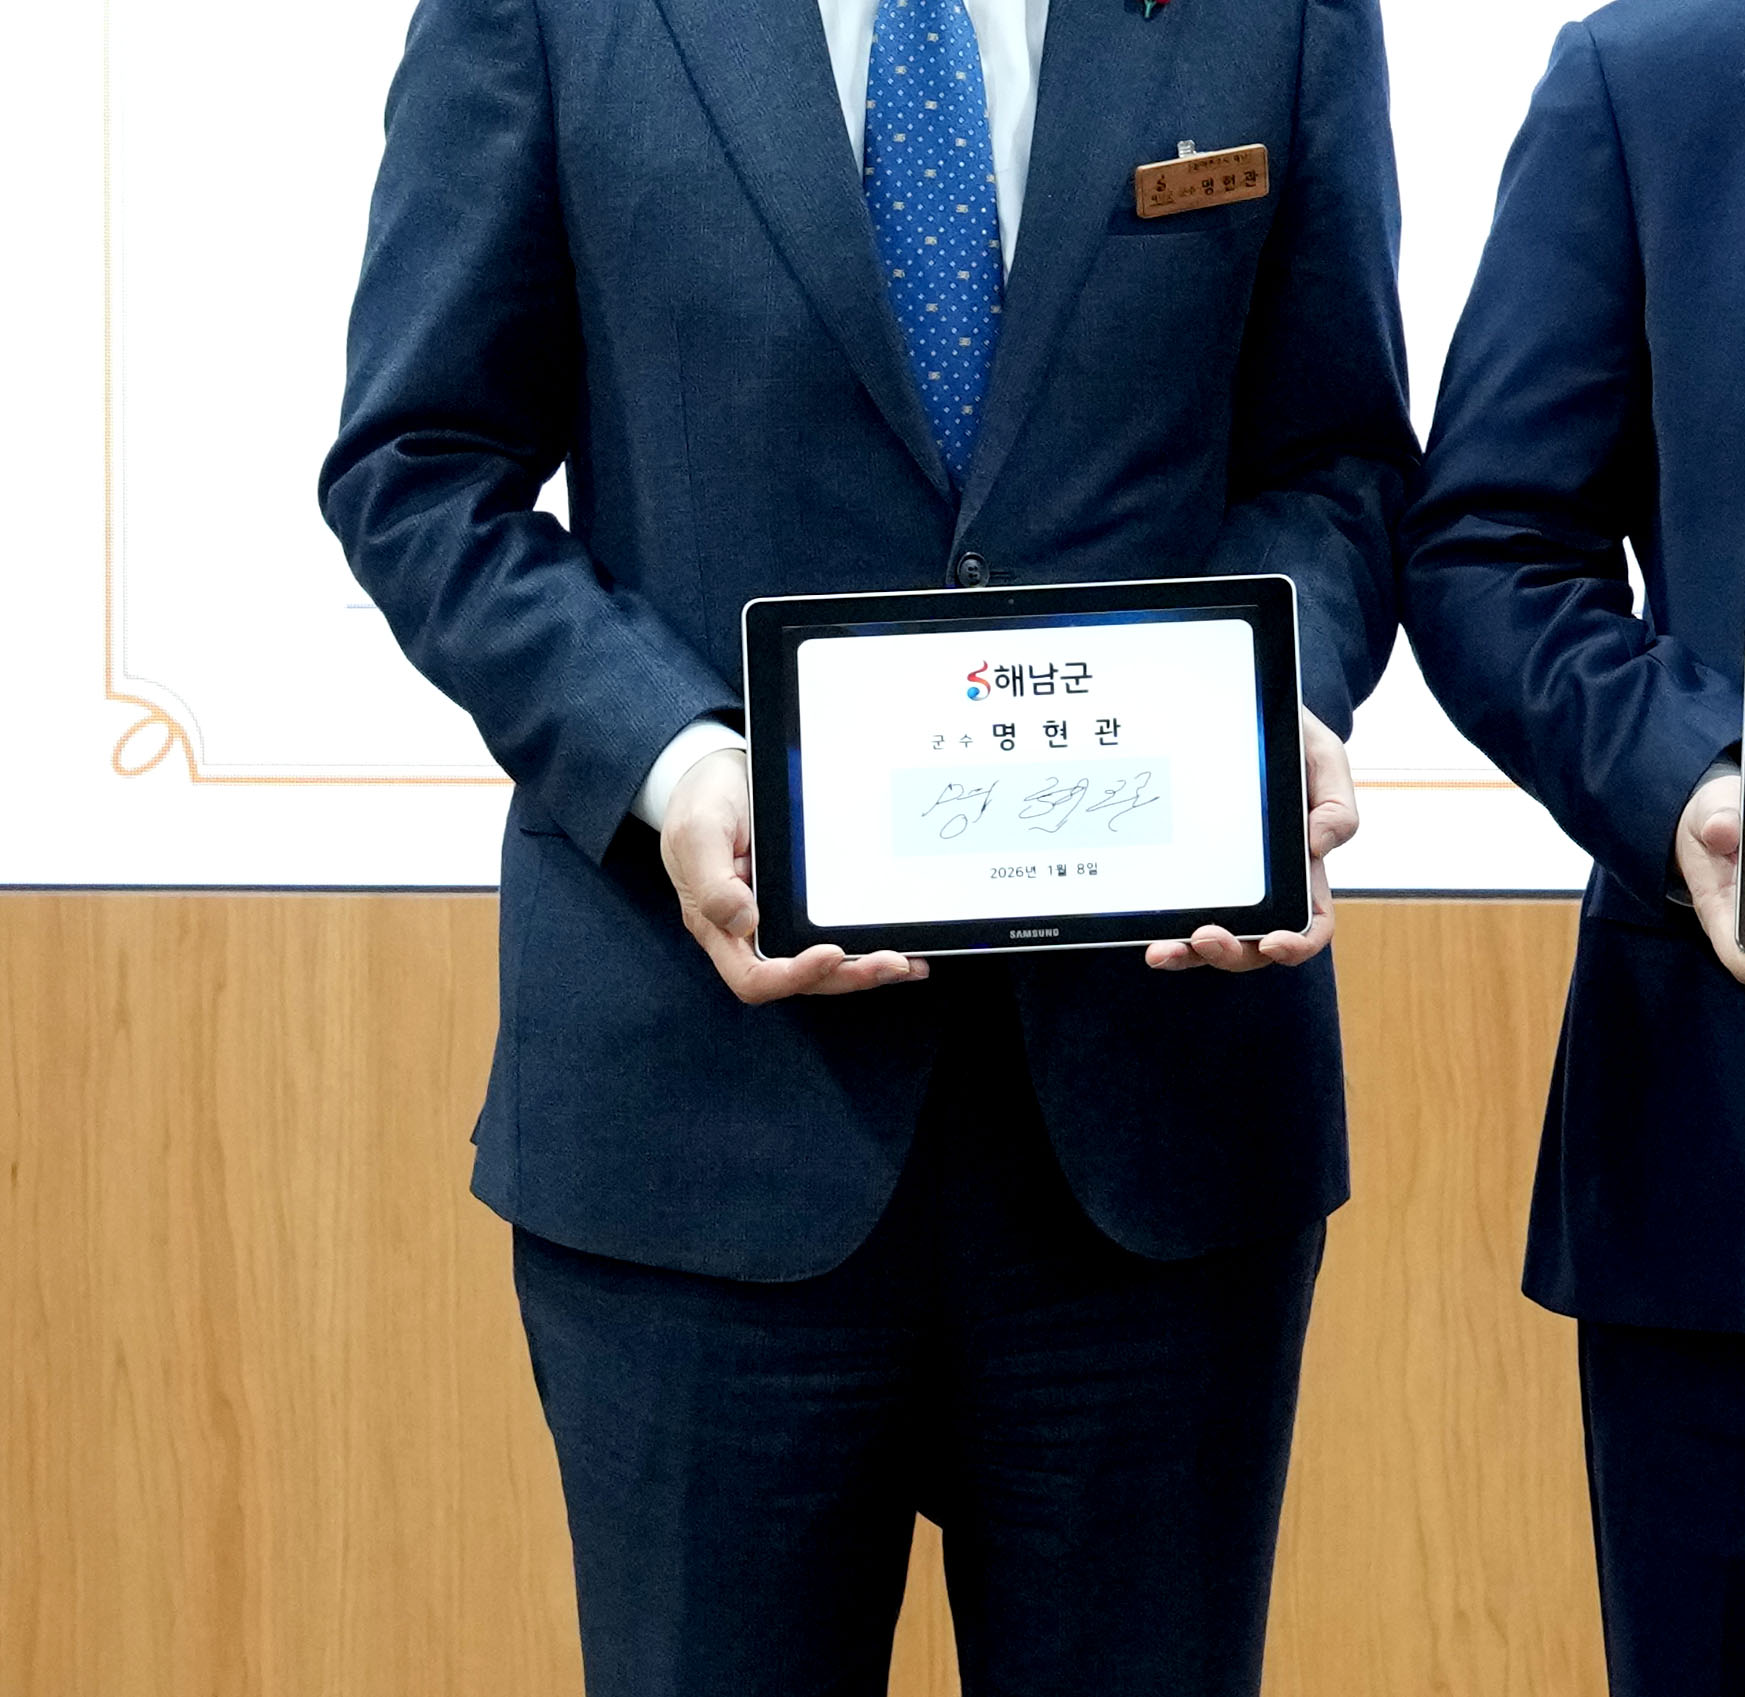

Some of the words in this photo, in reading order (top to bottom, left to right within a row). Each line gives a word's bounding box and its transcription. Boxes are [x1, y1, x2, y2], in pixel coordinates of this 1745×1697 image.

[993, 662, 1093, 697] 해남군
[991, 866, 1036, 879] 2026년
[1049, 864, 1067, 877] 1월
[1077, 864, 1098, 876] 8일
[1009, 928, 1060, 939] SAMSUNG
